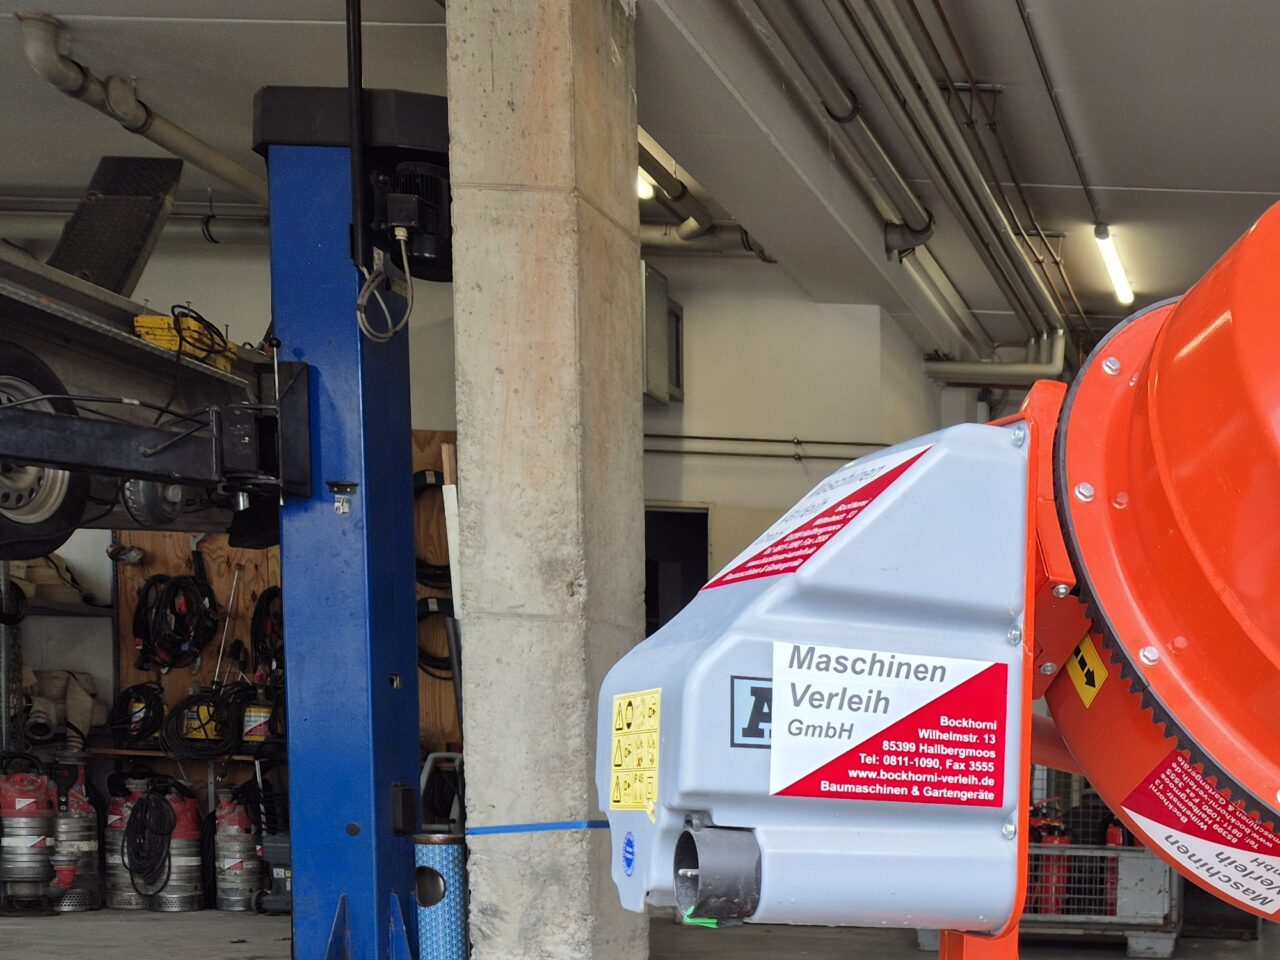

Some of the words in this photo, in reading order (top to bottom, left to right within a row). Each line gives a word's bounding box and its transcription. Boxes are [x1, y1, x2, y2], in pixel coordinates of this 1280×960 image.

[788, 645, 947, 682] Maschinen
[789, 682, 890, 714] Verleih
[787, 718, 854, 740] GmbH
[940, 716, 997, 730] Bockhorni
[918, 728, 980, 743] Wilhelmstr.
[983, 733, 996, 744] 13
[882, 740, 916, 752] 85399
[919, 743, 996, 758] Hallbergmoos
[859, 753, 879, 765] Tel:
[883, 755, 943, 770] 0811-1090,
[946, 760, 966, 771] Fax
[969, 761, 995, 772] 3555
[848, 769, 995, 786] www.bockhorni-verleih.de
[1154, 778, 1165, 790] 13
[1165, 768, 1185, 789] 3555
[1176, 755, 1226, 803] Gartengeräte
[820, 780, 908, 796] Baumaschinen
[911, 786, 920, 796] &
[923, 787, 995, 801] Gartengeräte
[1161, 772, 1214, 825] Hallbergmoos
[1184, 787, 1201, 804] Fax
[1149, 784, 1189, 824] Bockhorni
[1166, 788, 1208, 831] Wilhelmstr.
[1171, 762, 1273, 848] www.bockhorni-verleih.de
[1227, 803, 1235, 812] &
[1212, 824, 1239, 844] 85399
[1243, 836, 1259, 850] Tel:
[1164, 833, 1274, 907] Maschinen
